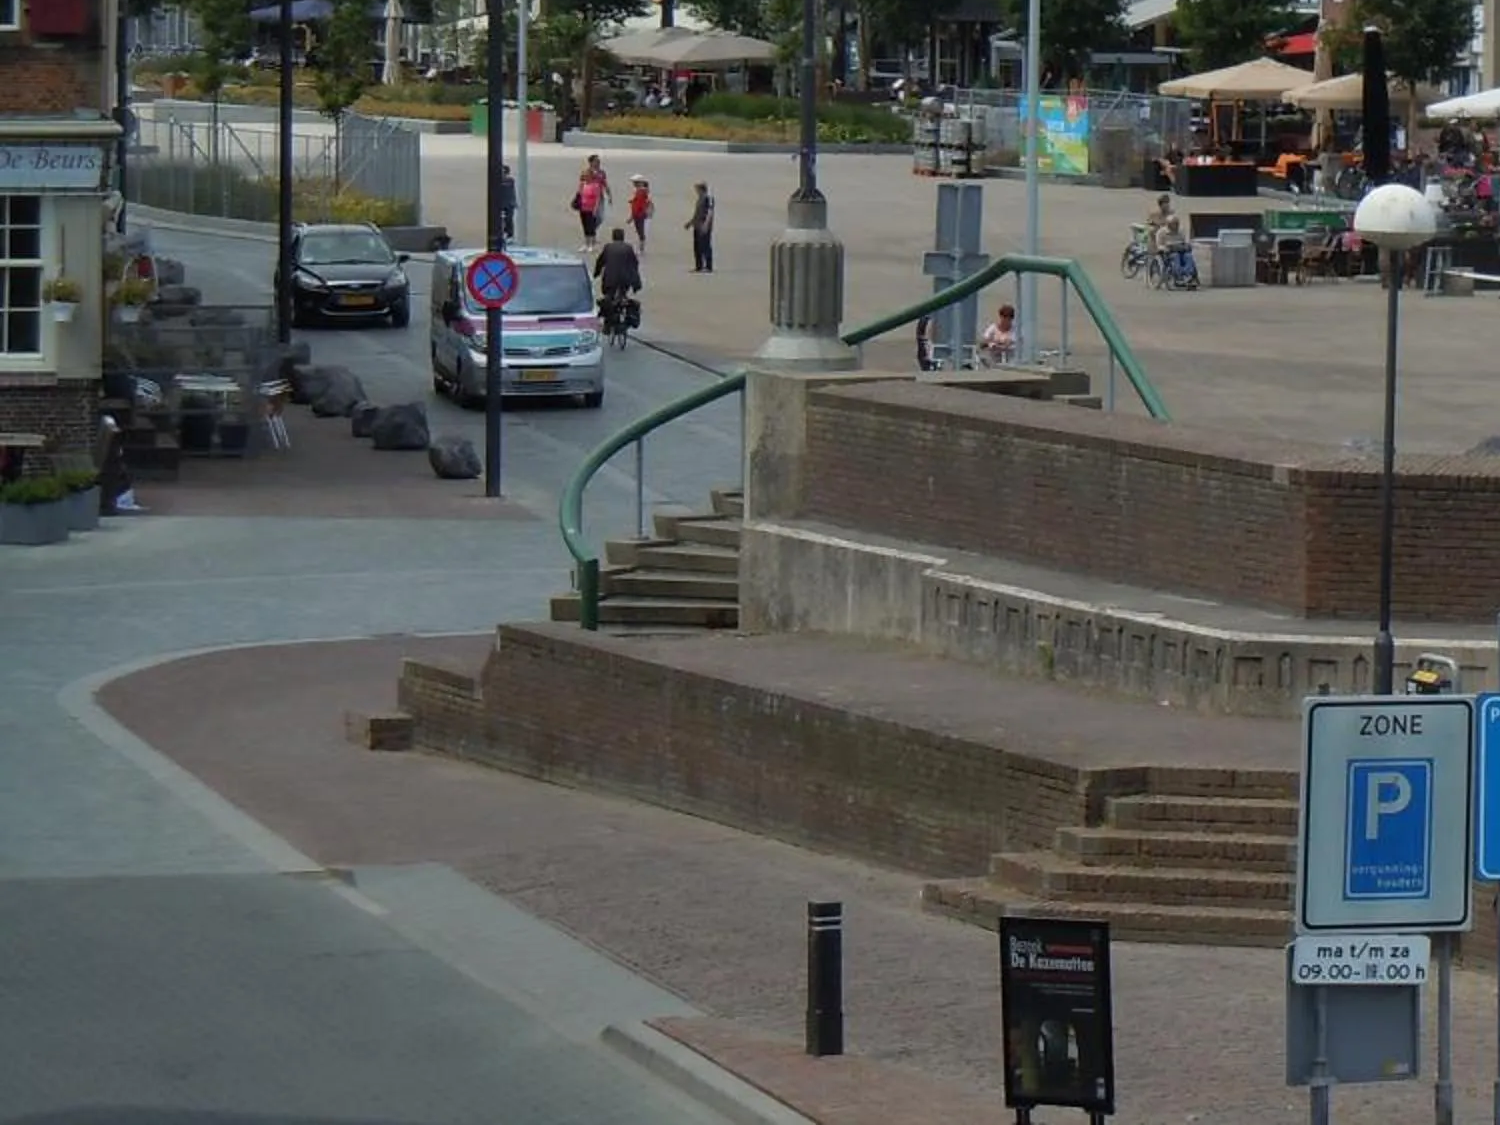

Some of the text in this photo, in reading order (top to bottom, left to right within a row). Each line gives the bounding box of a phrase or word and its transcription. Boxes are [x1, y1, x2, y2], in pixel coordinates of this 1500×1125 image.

[34, 147, 95, 170] Beurs
[1359, 714, 1423, 737] ZONE
[1364, 771, 1412, 841] P
[1317, 942, 1410, 959] ma t/m za
